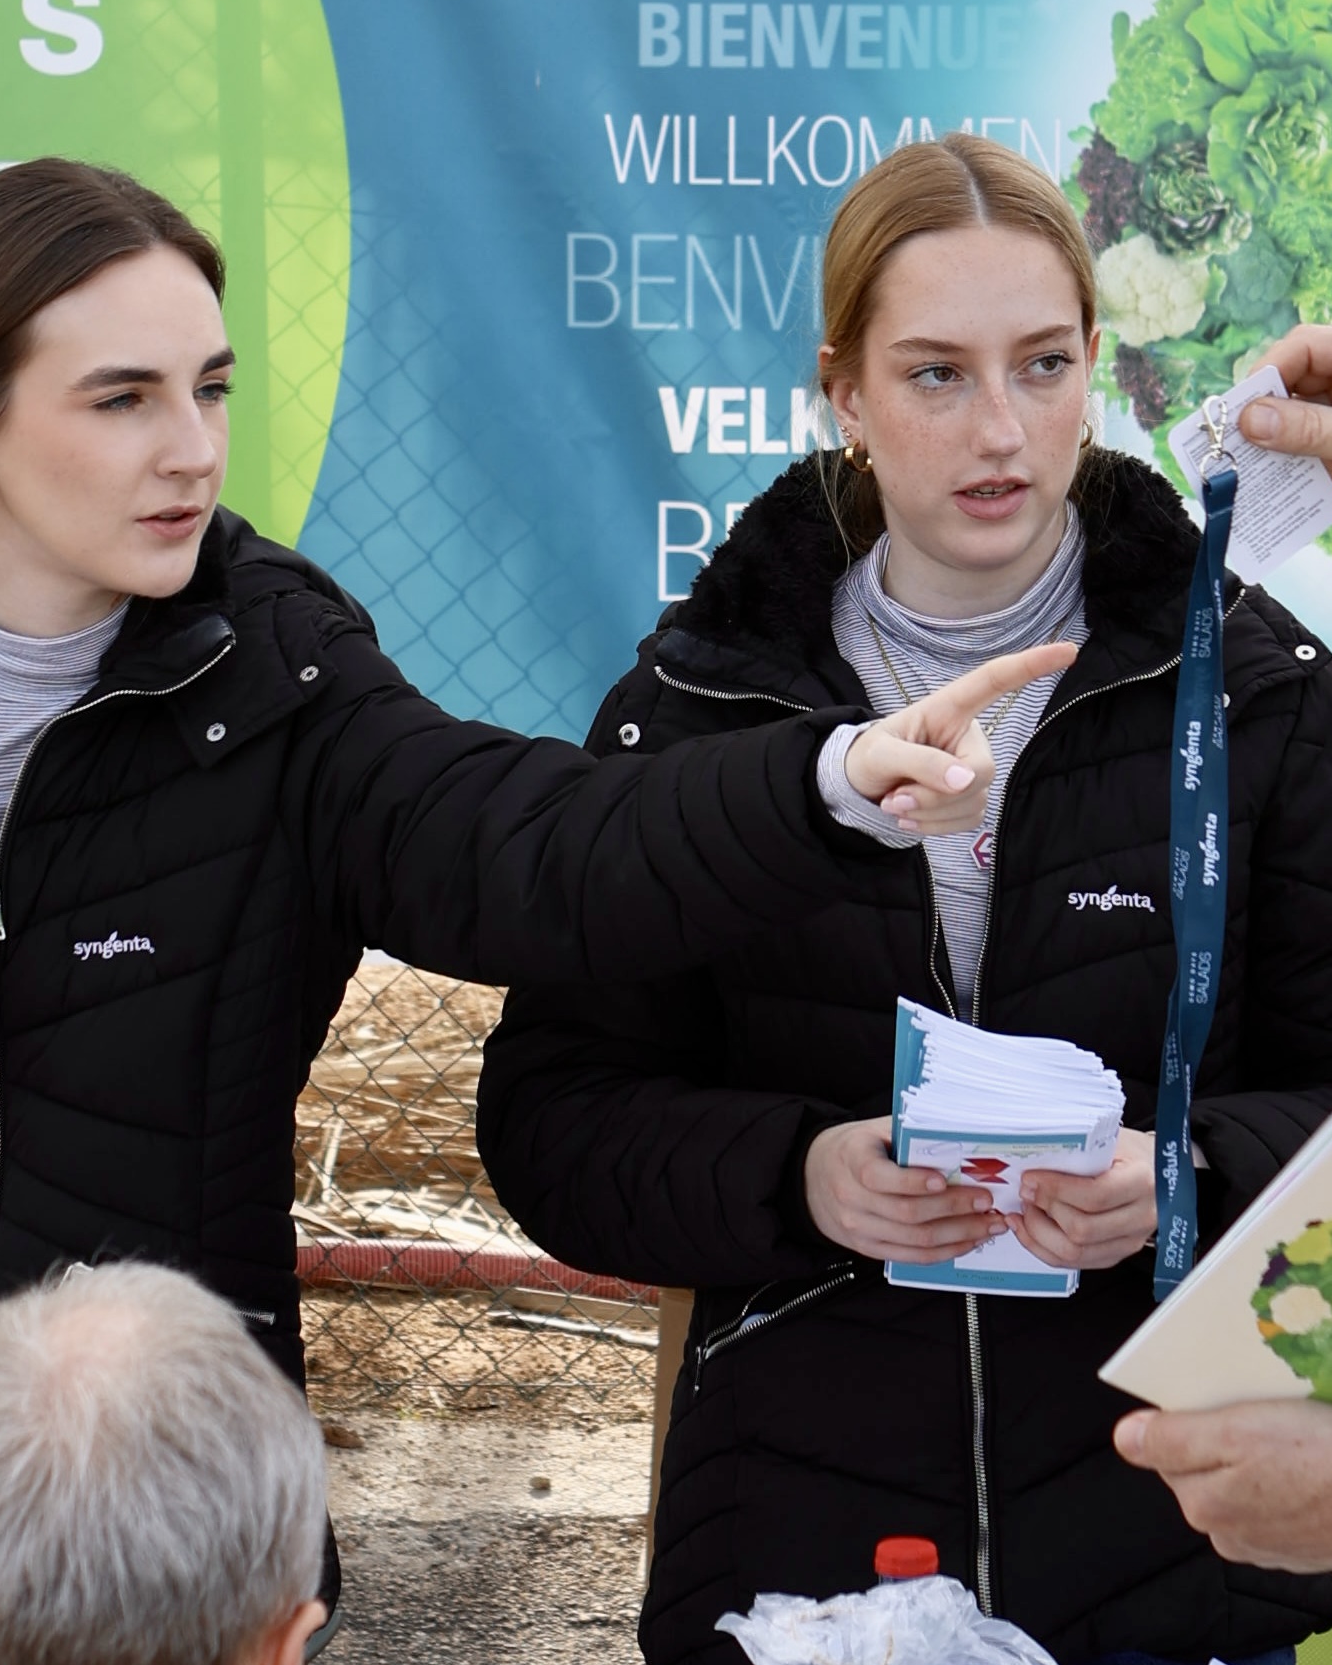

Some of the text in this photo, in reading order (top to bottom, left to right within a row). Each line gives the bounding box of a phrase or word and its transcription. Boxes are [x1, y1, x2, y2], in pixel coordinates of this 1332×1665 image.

[638, 1, 1025, 71] BIENVENUE
[566, 231, 821, 331] BENV
[1198, 606, 1214, 659] SALADS
[1180, 720, 1204, 792] syngenta
[1199, 812, 1221, 887] syngenta
[1068, 885, 1154, 912] syngenta
[73, 931, 155, 960] syngenta
[1196, 951, 1212, 1005] SALADS
[1163, 1140, 1180, 1201] synge
[1164, 1215, 1182, 1269] SALADS
